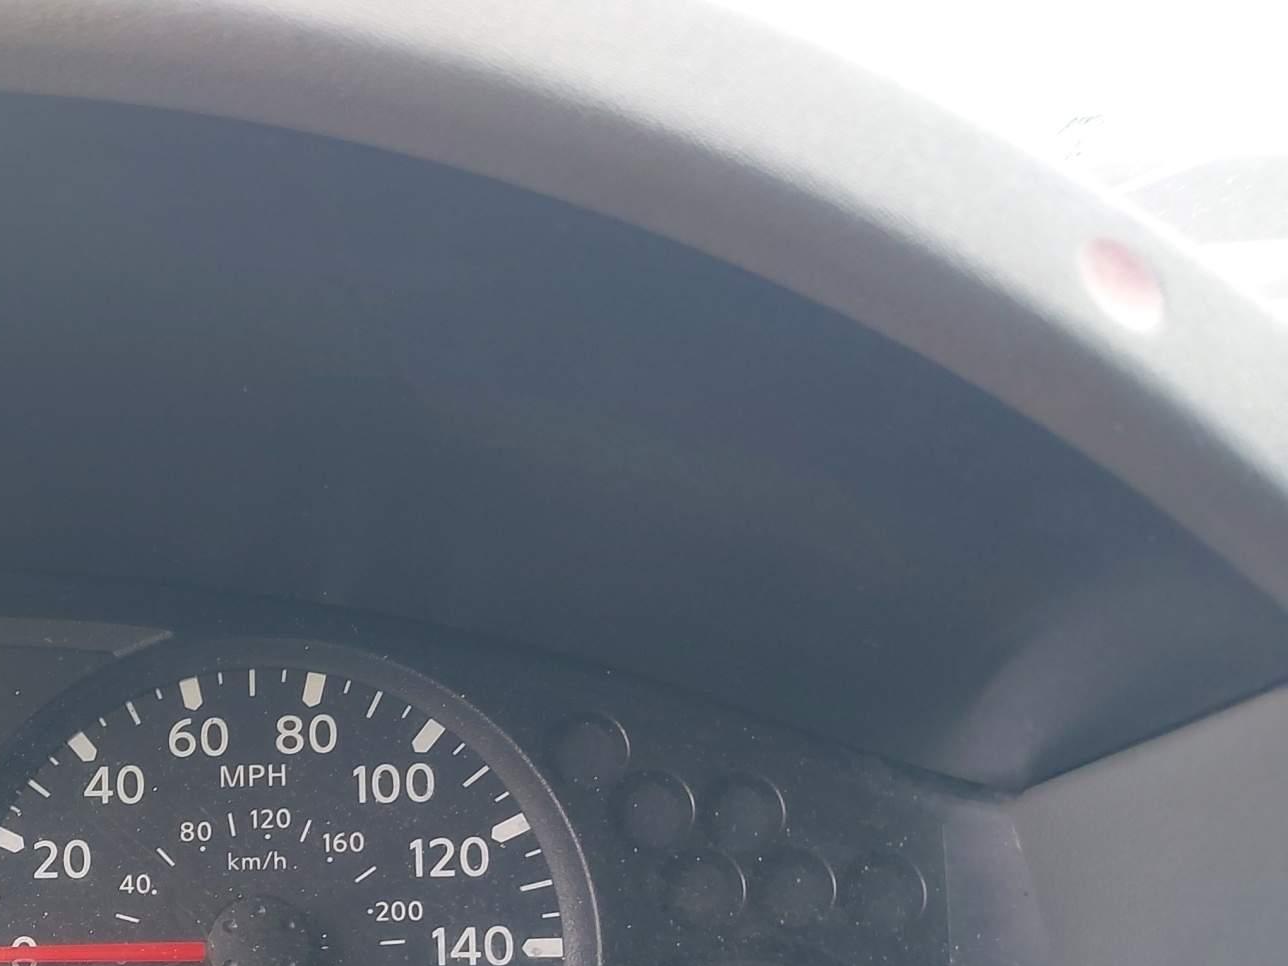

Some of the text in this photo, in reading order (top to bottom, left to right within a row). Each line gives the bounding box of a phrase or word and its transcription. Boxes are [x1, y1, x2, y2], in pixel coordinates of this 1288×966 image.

[168, 717, 229, 758] 60
[275, 715, 337, 755] 80
[83, 765, 145, 805] 40
[220, 763, 287, 788] MPH
[352, 762, 435, 804] 100
[180, 821, 212, 842] 80
[250, 808, 291, 829] 120
[323, 831, 365, 853] 160
[409, 836, 489, 878] 120
[33, 838, 92, 879] 20
[227, 850, 287, 872] km/h
[119, 874, 151, 895] 40
[375, 901, 423, 922] 200
[431, 925, 514, 966] 140
